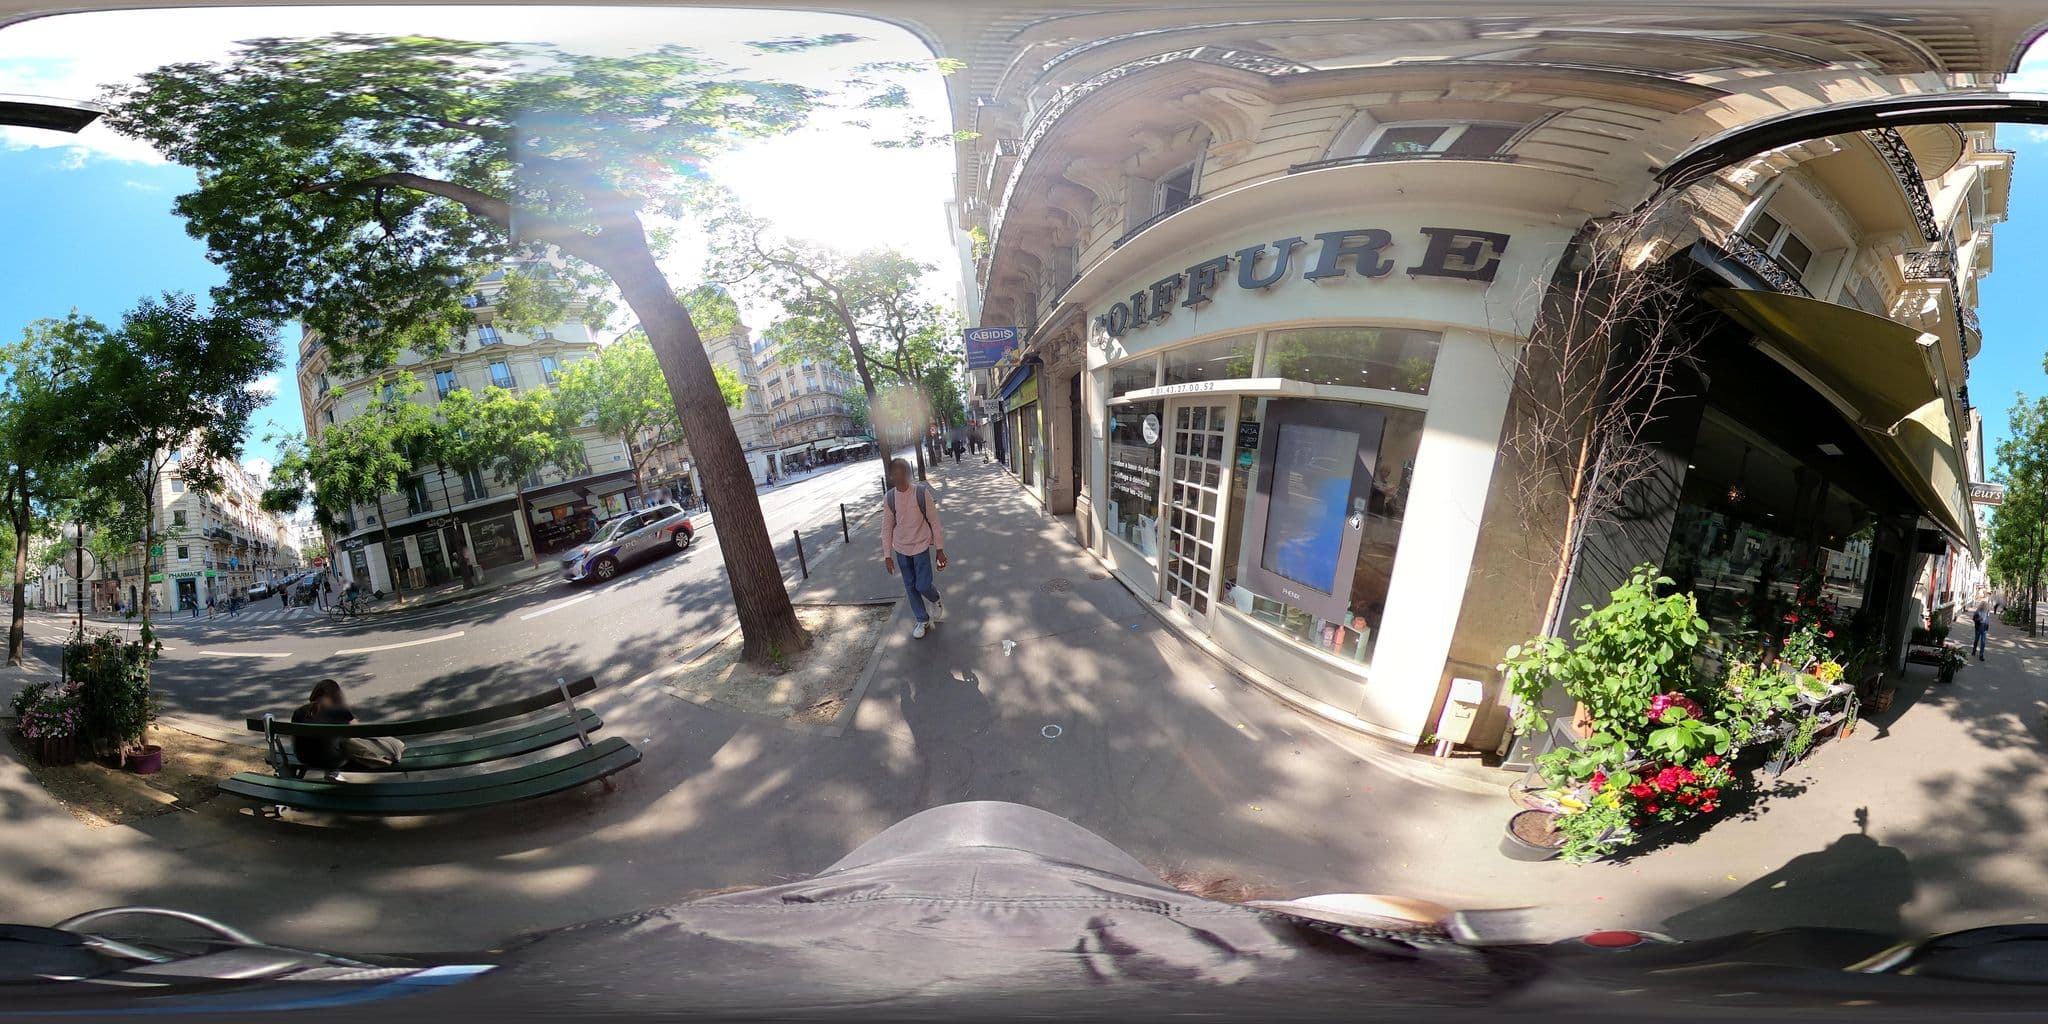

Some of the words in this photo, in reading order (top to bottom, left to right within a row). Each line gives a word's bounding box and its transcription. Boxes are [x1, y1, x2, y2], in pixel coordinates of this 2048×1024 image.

[1090, 227, 1510, 347] COIFFURE
[973, 330, 1012, 340] ABIDIS
[168, 571, 203, 579] PHARMACIE
